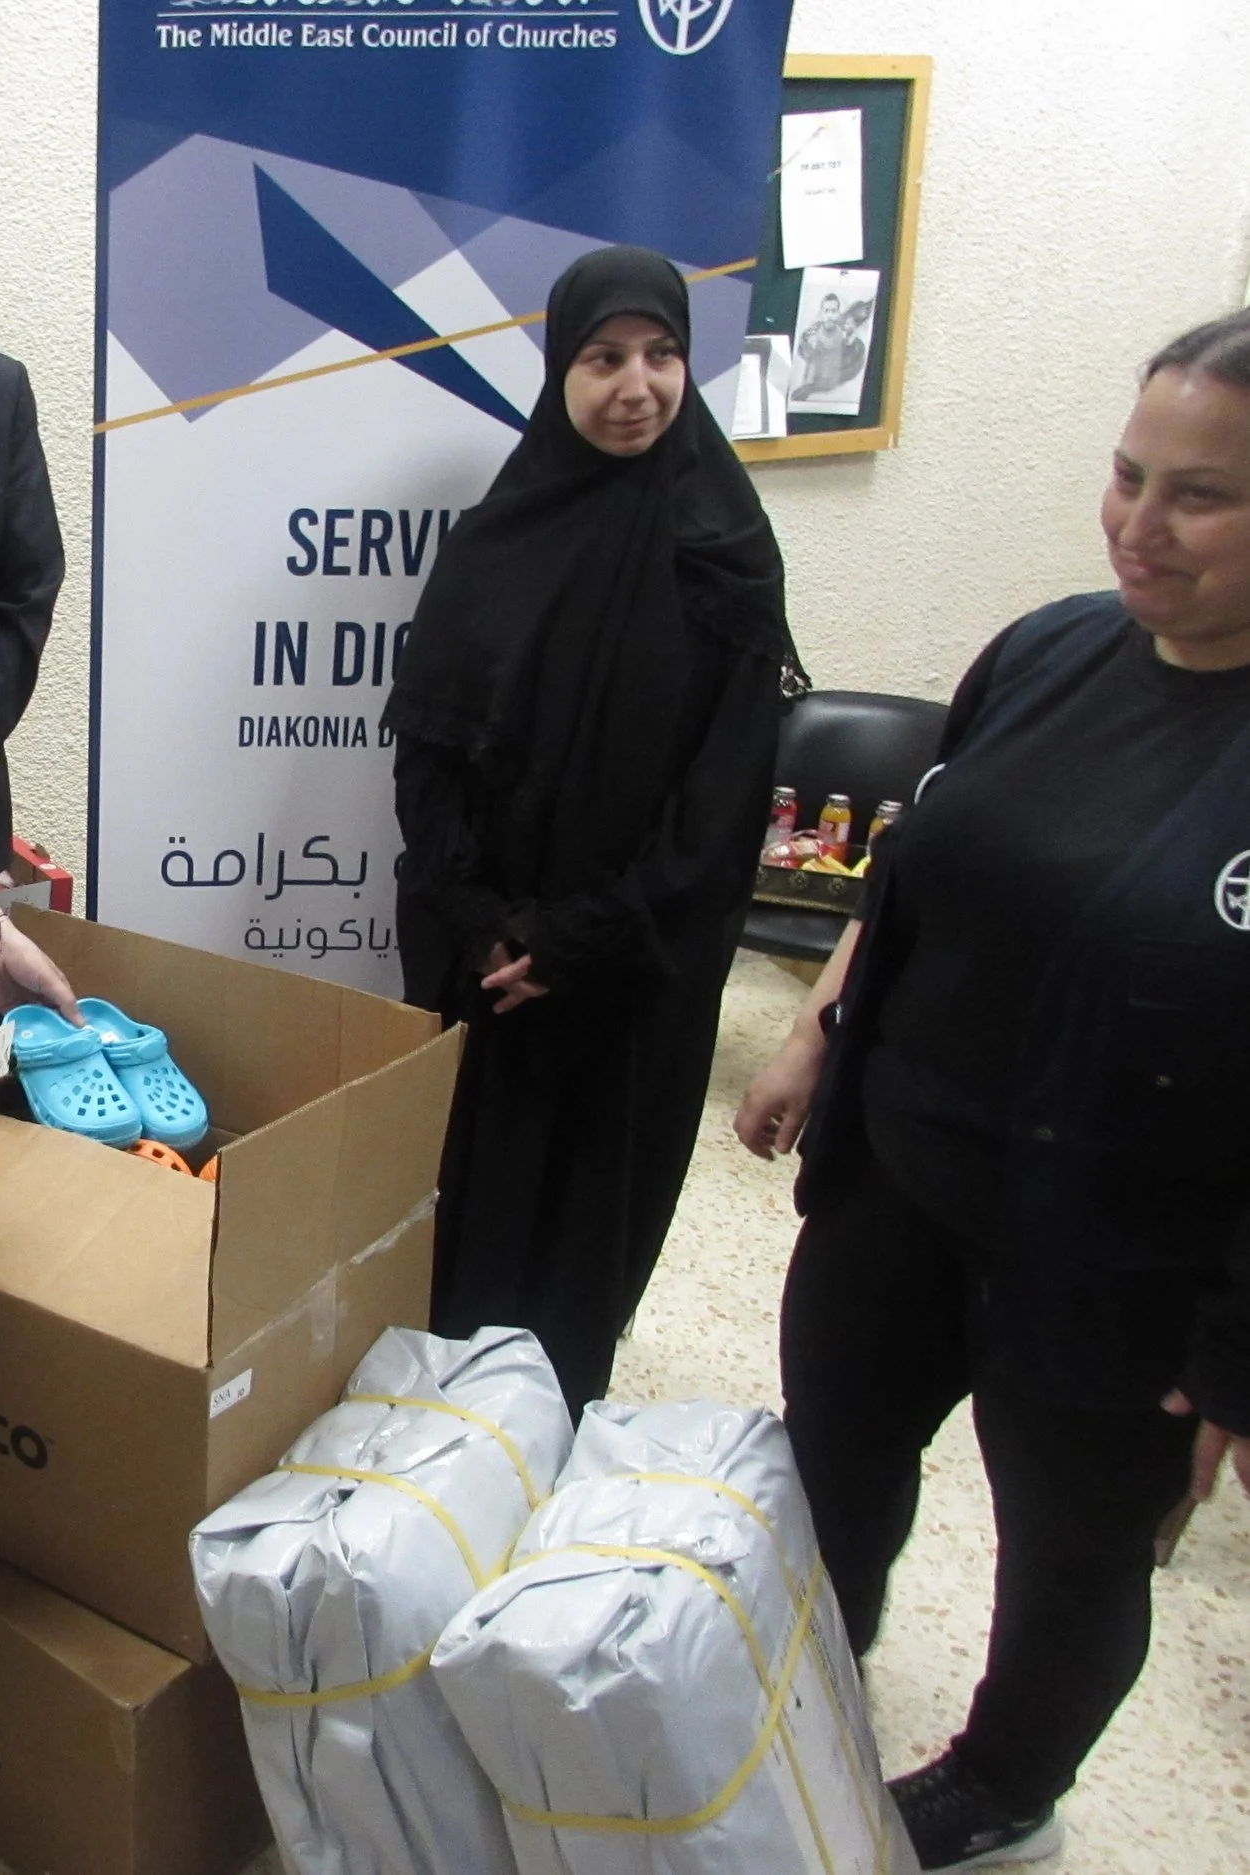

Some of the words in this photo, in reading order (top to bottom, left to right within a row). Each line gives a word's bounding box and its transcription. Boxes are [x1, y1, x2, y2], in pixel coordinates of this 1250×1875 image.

[156, 25, 202, 48] The
[210, 22, 293, 47] Middle
[301, 24, 354, 47] East
[362, 22, 458, 47] Council
[465, 22, 493, 47] of
[497, 23, 617, 48] Churches
[286, 508, 450, 577] SERV
[252, 620, 309, 686] IN
[238, 715, 368, 748] DIAKONIA
[161, 832, 368, 900] بكرامة
[244, 917, 400, 959] ياكونية
